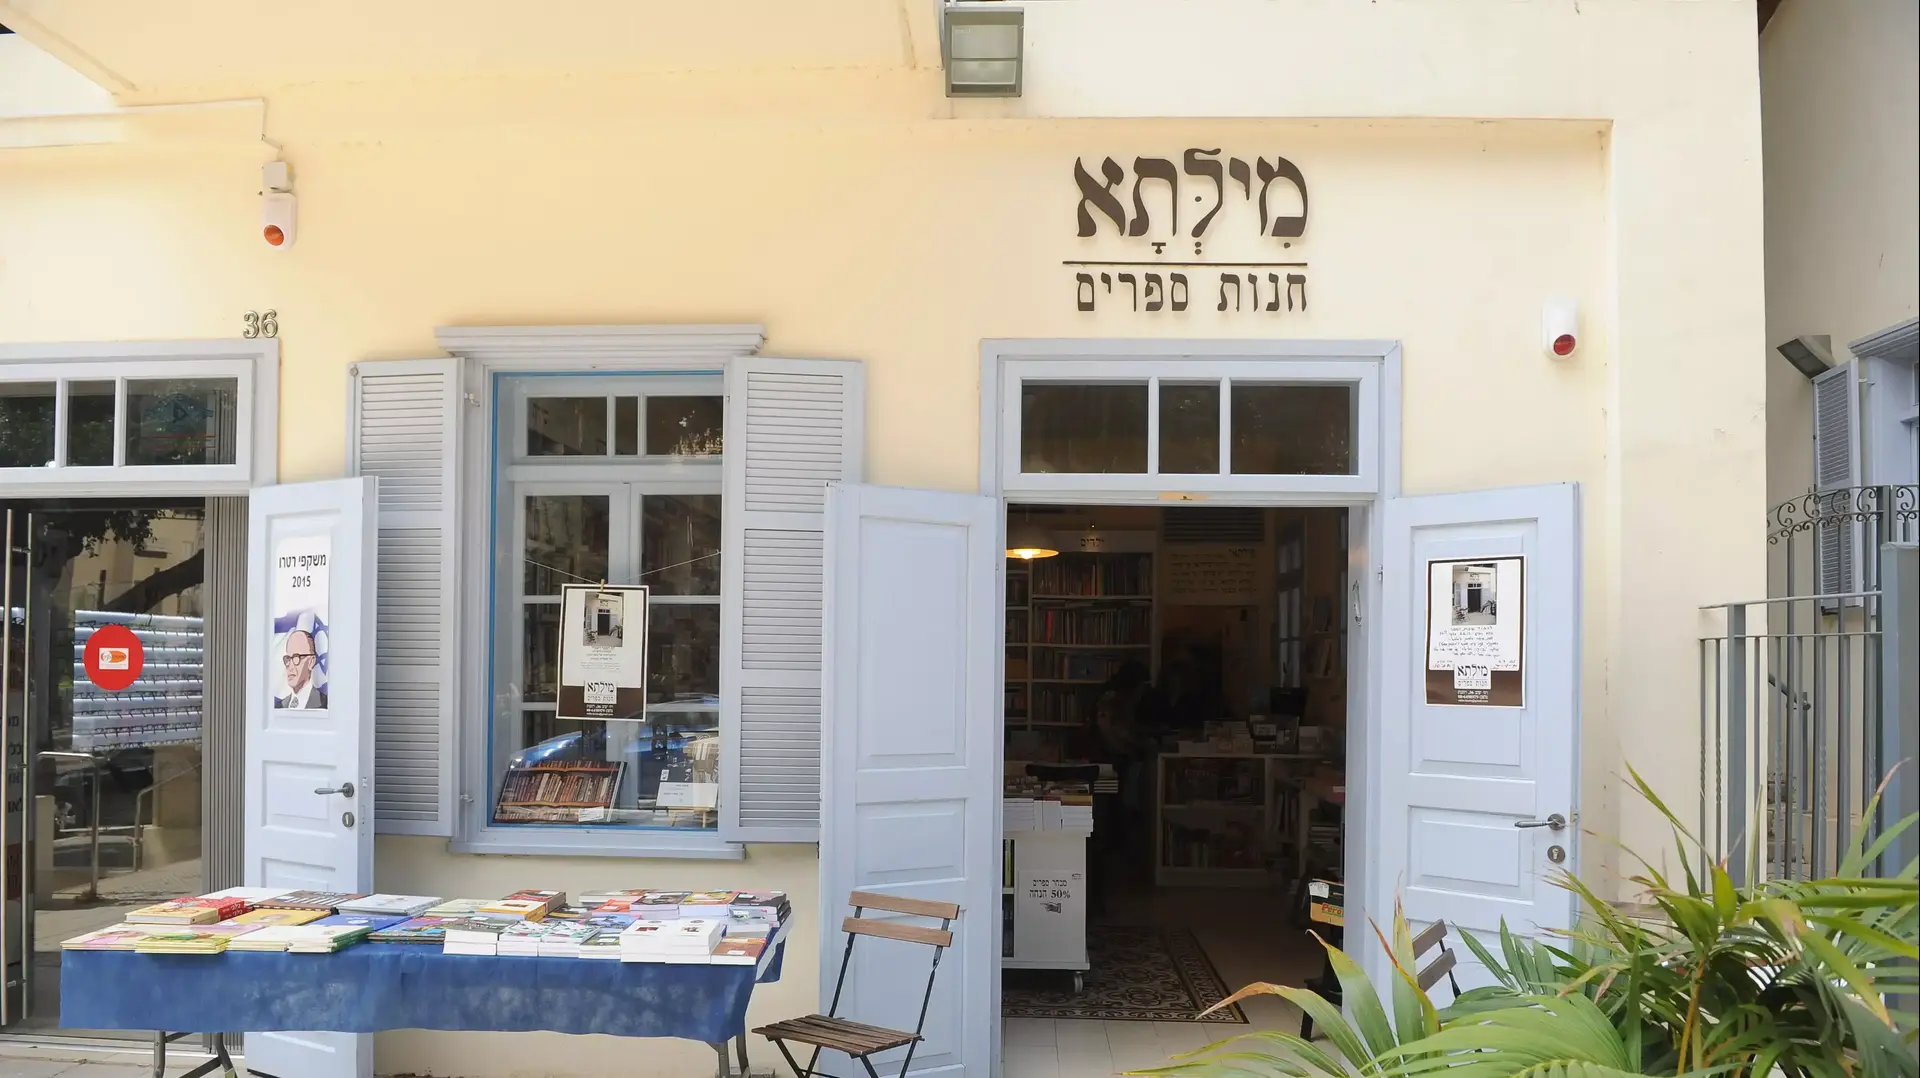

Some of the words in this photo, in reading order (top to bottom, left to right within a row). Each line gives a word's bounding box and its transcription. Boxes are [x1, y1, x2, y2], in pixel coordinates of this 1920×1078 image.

[1076, 272, 1188, 312] ספרים
[1217, 272, 1307, 312] חנות
[242, 308, 279, 339] 36
[279, 556, 297, 568] רטרו
[298, 554, 326, 571] משקפי
[292, 575, 311, 588] 2015
[1032, 879, 1049, 887] ספרים
[1052, 879, 1068, 887] מבחר
[1029, 889, 1047, 898] הנחה
[1051, 889, 1071, 899] 50%
